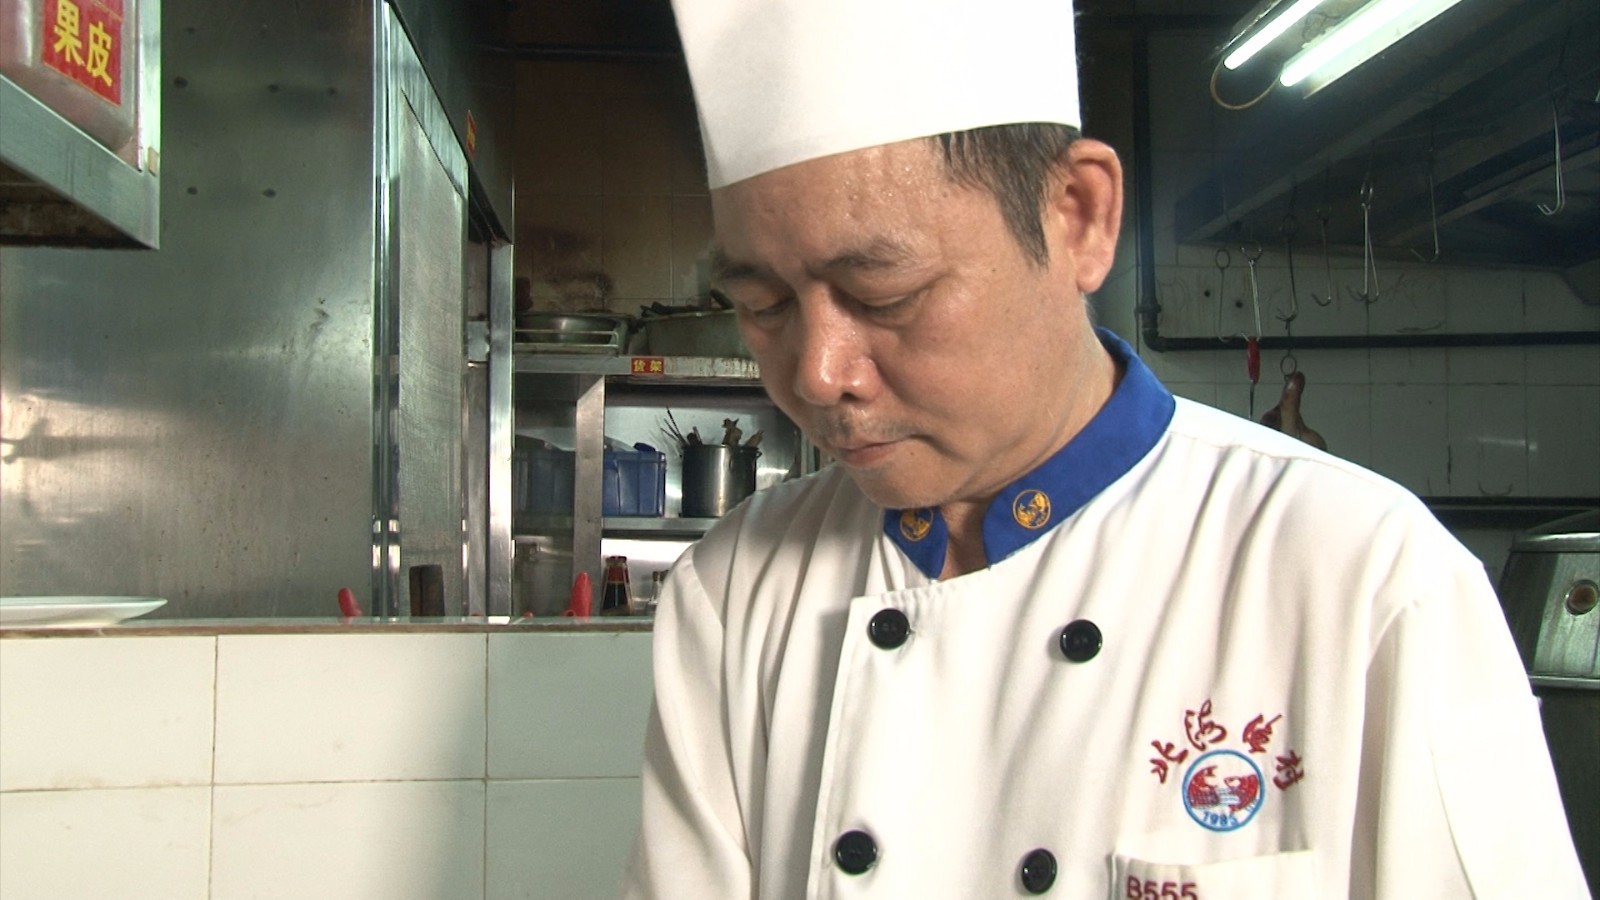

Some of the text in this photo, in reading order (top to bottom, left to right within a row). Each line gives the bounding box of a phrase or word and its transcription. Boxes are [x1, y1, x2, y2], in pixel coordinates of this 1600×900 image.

[53, 0, 113, 87] 果皮
[1203, 810, 1238, 826] 1985
[1127, 875, 1198, 900] B555
